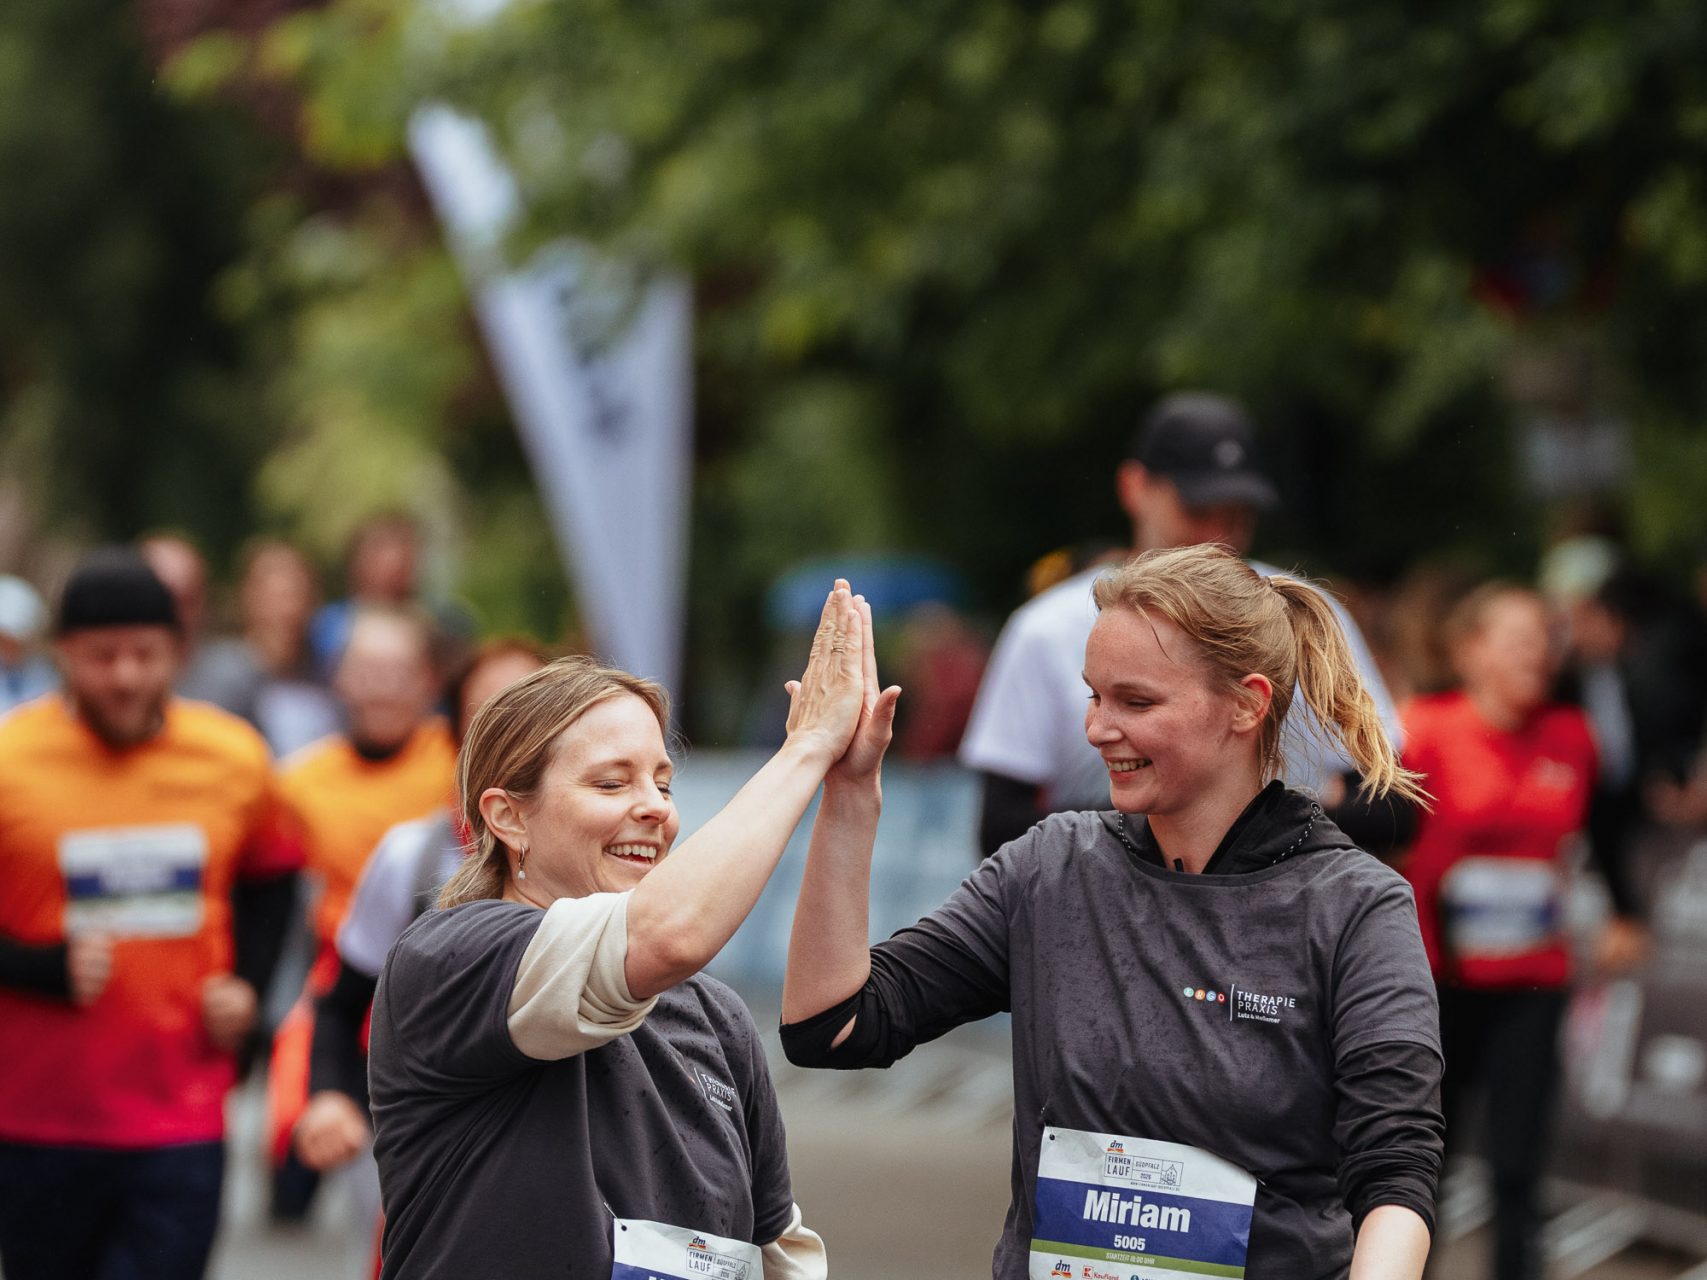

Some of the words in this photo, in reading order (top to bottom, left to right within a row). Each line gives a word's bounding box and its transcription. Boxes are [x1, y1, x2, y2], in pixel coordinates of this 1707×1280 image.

[1237, 991, 1296, 1008] THERAPIE
[1238, 1001, 1278, 1015] PRAXIS
[706, 1082, 732, 1102] PRAXIS
[1110, 1140, 1123, 1149] dm
[1108, 1156, 1131, 1165] FIRMEN
[1107, 1164, 1130, 1176] LAUF
[1082, 1189, 1191, 1233] Miriam
[692, 1236, 706, 1245] dm
[1113, 1234, 1146, 1251] 5005
[689, 1251, 713, 1262] FIRMEN
[689, 1259, 711, 1272] LAUF
[1055, 1260, 1070, 1272] dm
